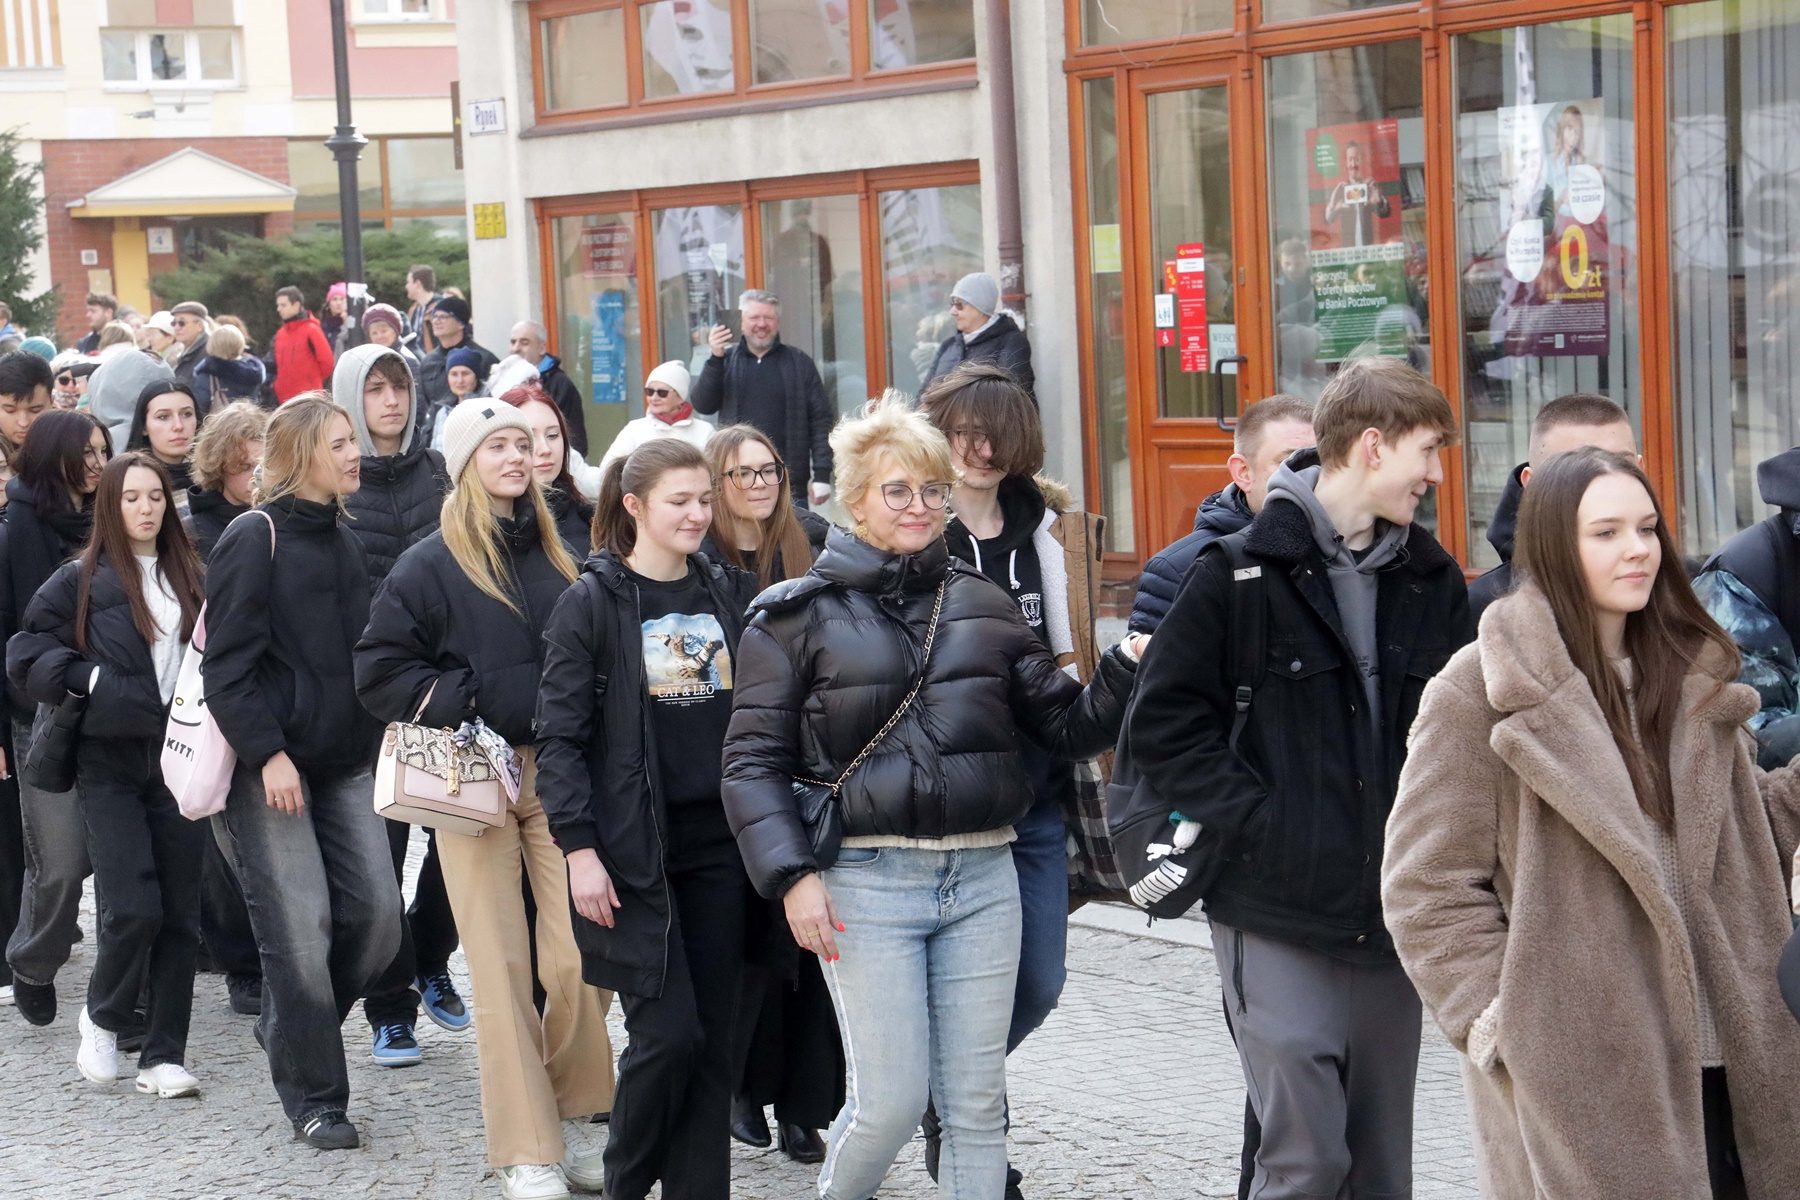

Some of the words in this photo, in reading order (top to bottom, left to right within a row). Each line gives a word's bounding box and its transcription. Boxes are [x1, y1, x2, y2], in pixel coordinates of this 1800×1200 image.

[474, 105, 497, 130] Rynek
[1560, 225, 1589, 290] 0
[657, 687, 680, 698] CAT
[682, 686, 691, 697] &
[693, 684, 715, 696] LEO
[166, 737, 195, 762] KITT
[1129, 858, 1188, 909] PUMA
